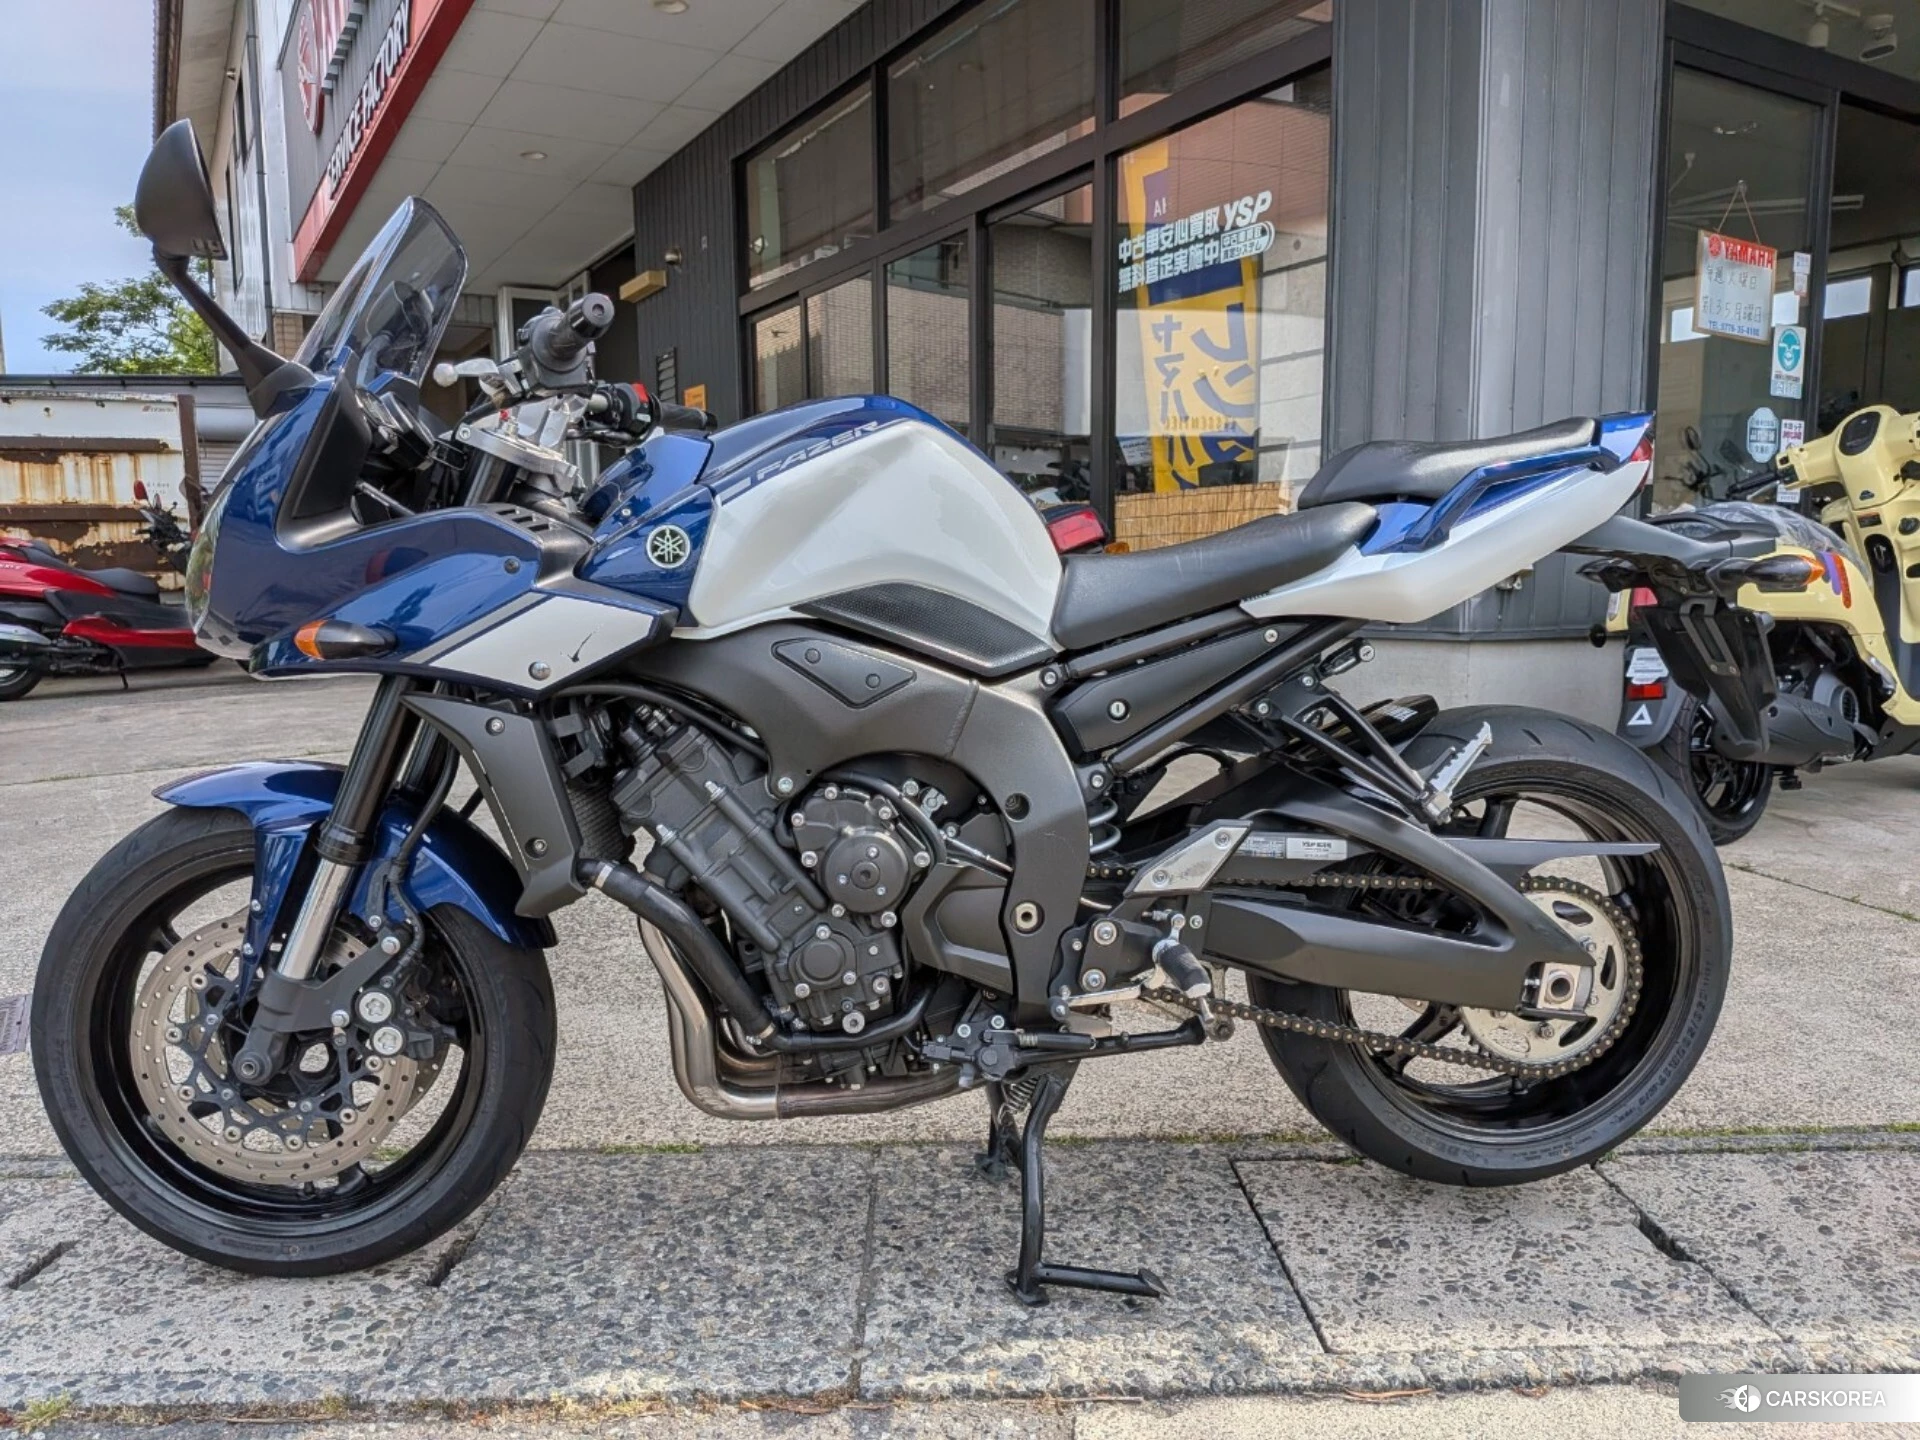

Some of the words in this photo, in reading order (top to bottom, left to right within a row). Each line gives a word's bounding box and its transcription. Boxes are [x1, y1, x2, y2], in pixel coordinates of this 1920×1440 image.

[327, 96, 363, 199] SERVICE
[361, 0, 410, 129] FACTORY
[1118, 206, 1220, 264] 中古車安心買取
[1223, 190, 1272, 231] YSP
[1722, 241, 1774, 270] YAMAHA
[1118, 239, 1220, 293] 無料査定実施中
[756, 421, 879, 481] FAZER
